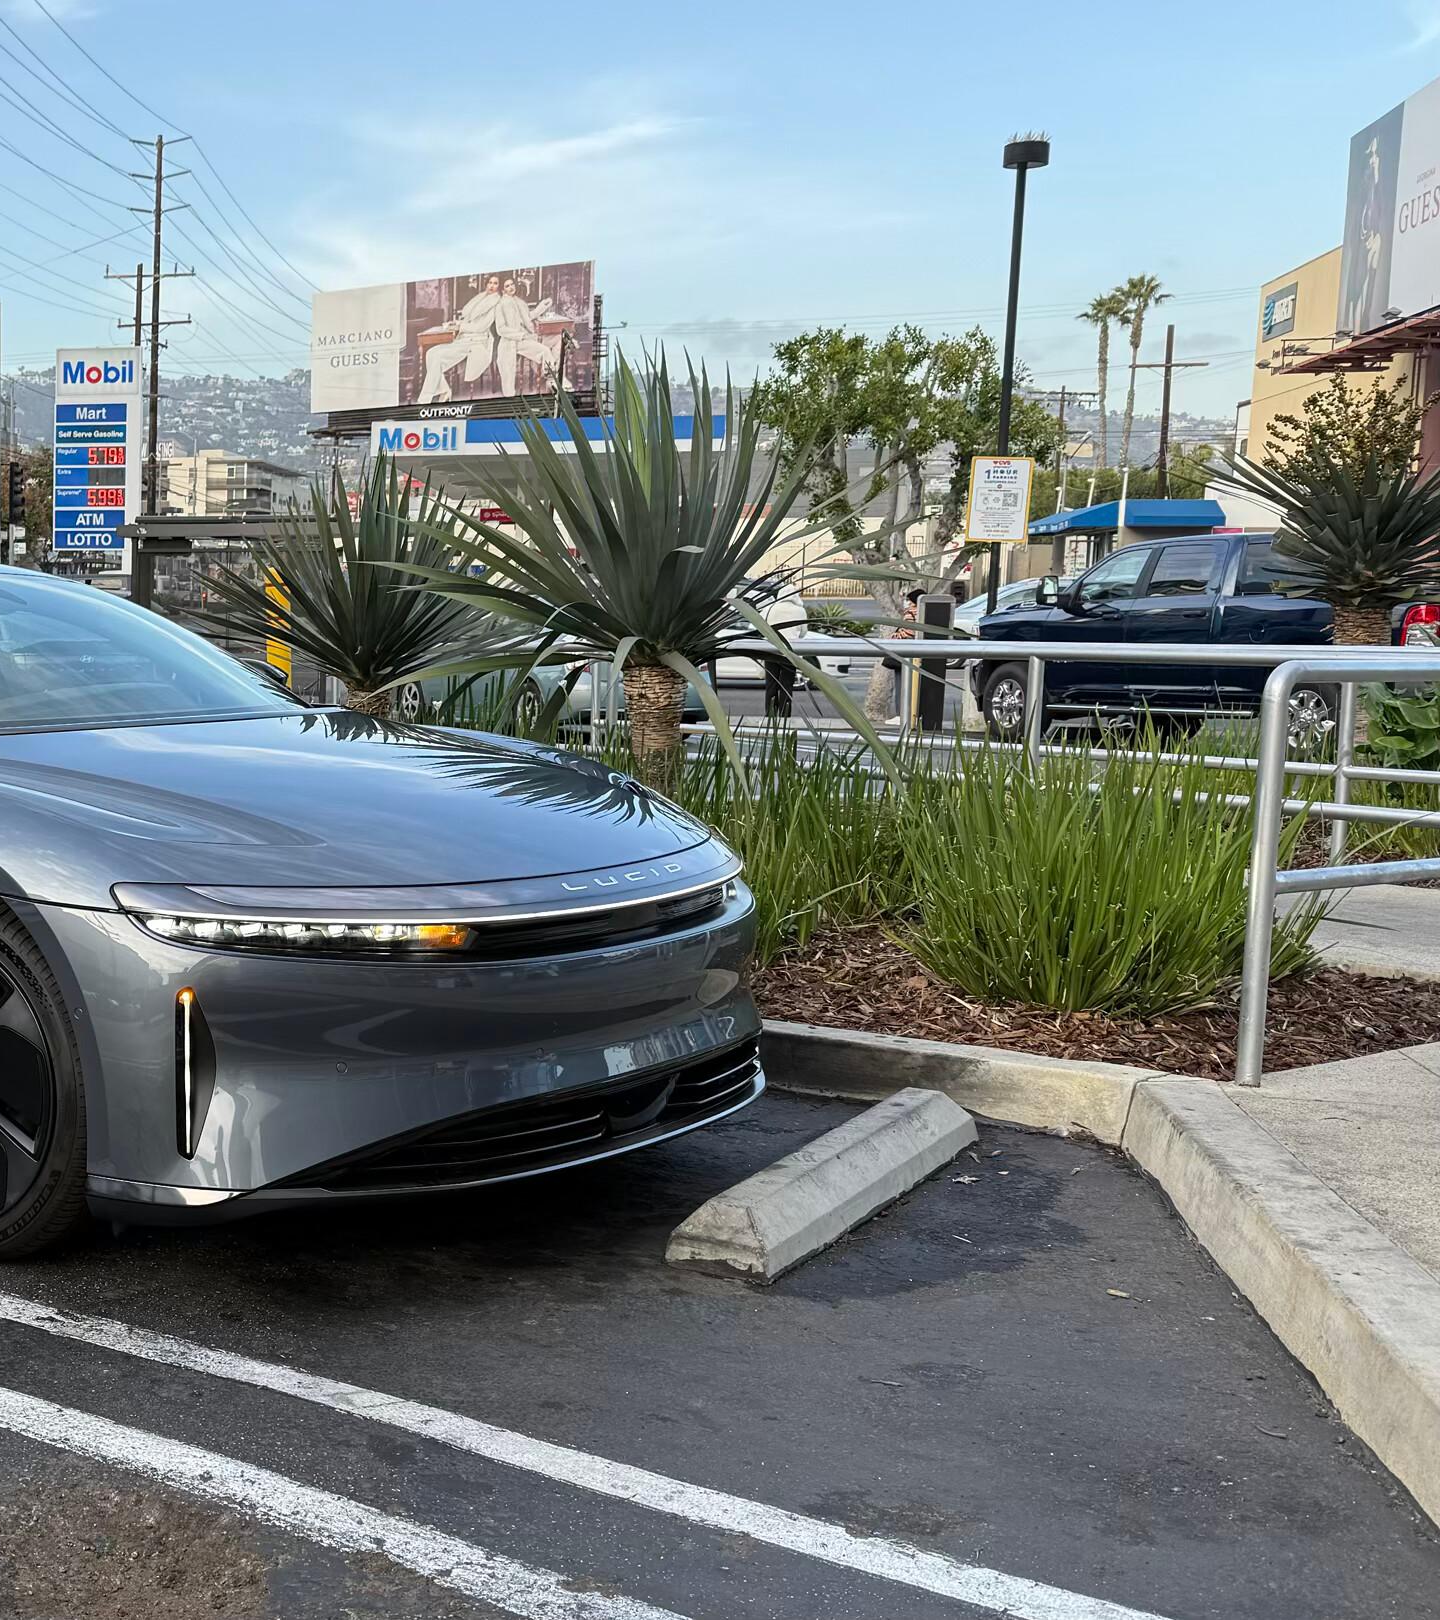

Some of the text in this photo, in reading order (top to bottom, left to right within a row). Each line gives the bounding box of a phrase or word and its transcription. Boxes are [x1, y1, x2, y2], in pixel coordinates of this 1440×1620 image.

[318, 328, 393, 346] MARCIANO
[330, 352, 379, 369] GUESS
[63, 360, 134, 385] Mobil
[75, 407, 107, 420] Mart
[58, 430, 124, 438] Self Serve Gasoline
[379, 427, 457, 450] Mobil
[75, 514, 104, 526] ATM
[66, 533, 112, 546] LOTTO
[561, 863, 683, 892] LUCID
